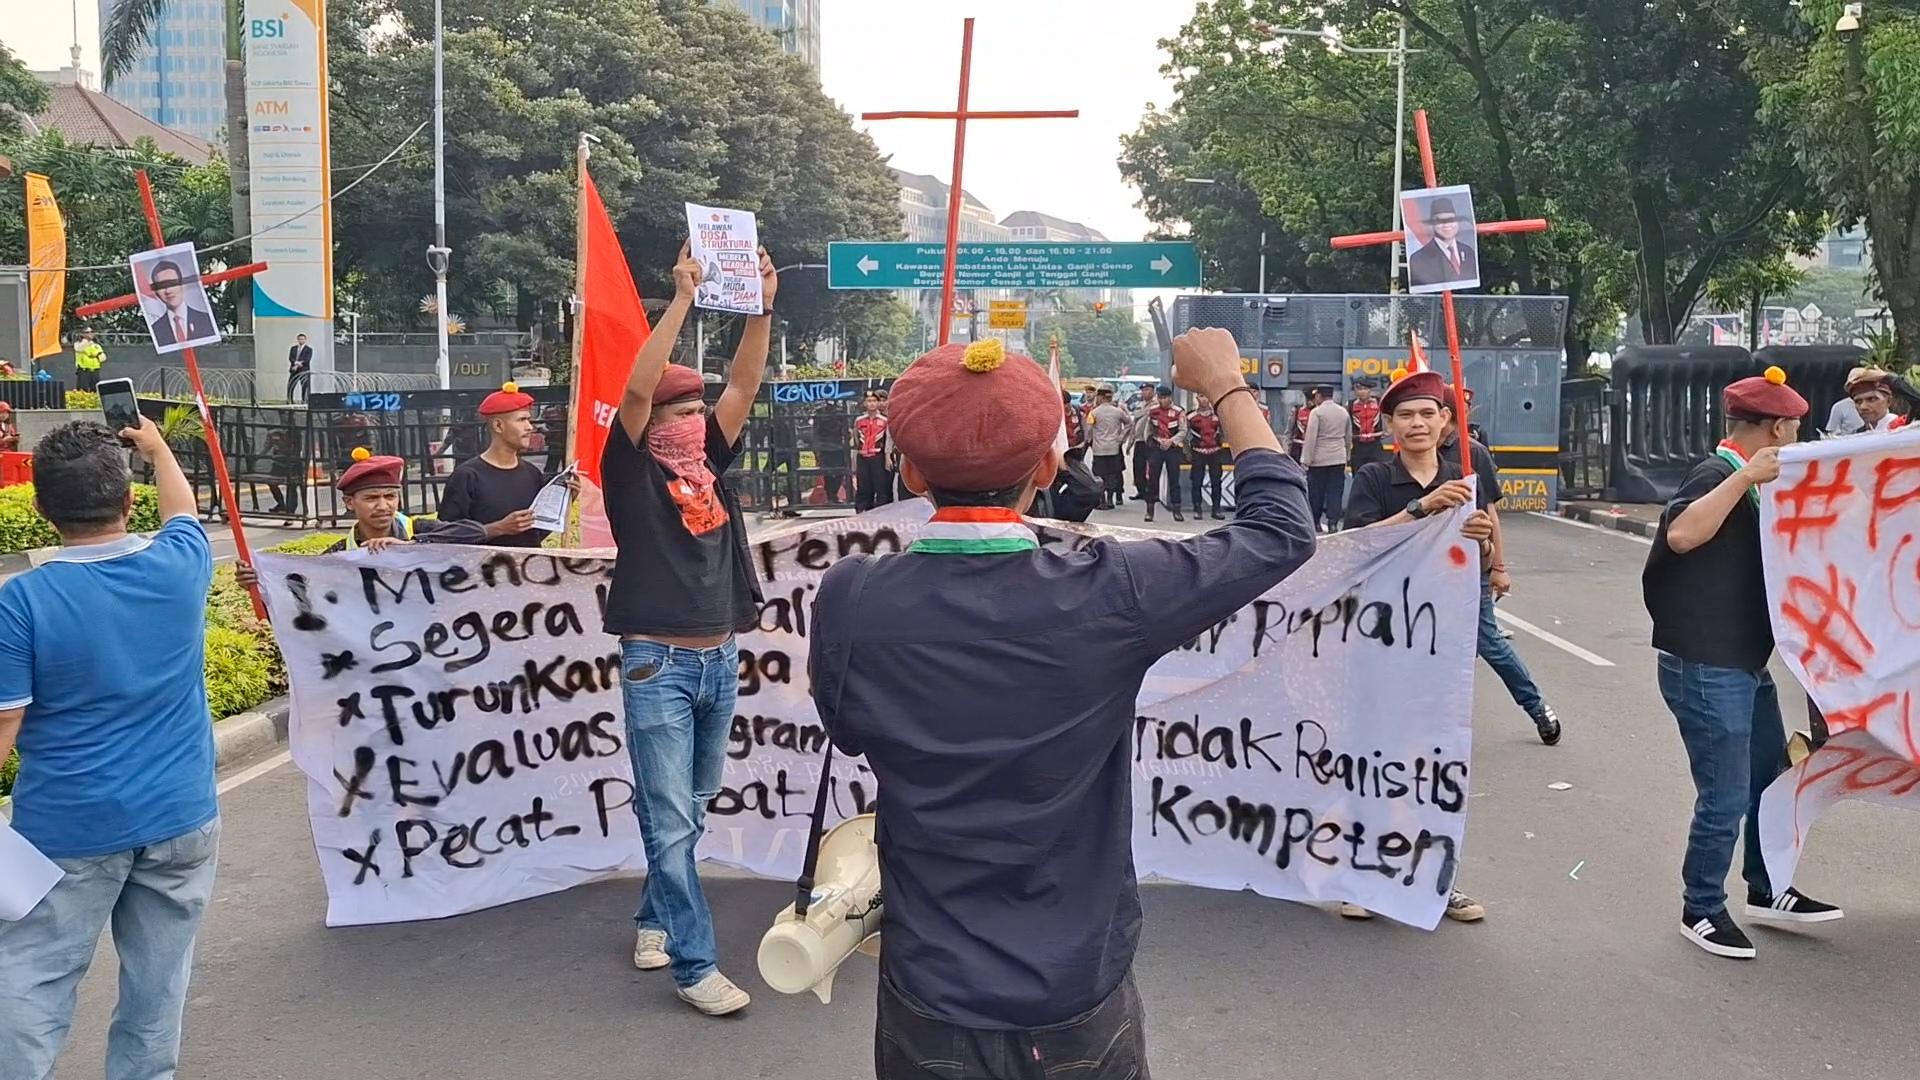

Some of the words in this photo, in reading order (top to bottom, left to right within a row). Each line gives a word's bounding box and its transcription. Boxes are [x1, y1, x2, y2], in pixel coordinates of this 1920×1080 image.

[252, 19, 284, 38] BSI
[256, 101, 288, 115] ATM
[698, 223, 733, 231] MELAWAN
[701, 231, 728, 240] DOSA
[702, 240, 753, 249] STRUKTURAL
[995, 247, 1021, 255] 10.00
[1025, 247, 1046, 255] dan
[1084, 247, 1113, 255] 21.00
[1013, 255, 1049, 263] Menuju
[919, 270, 945, 278] Berpl
[958, 270, 990, 278] Nomor
[994, 270, 1022, 278] Ganjil
[1025, 270, 1035, 278] di
[1040, 270, 1078, 279] Tanggal
[1081, 270, 1109, 278] Ganjil
[722, 282, 745, 291] MUDA
[990, 278, 1023, 286] Genap
[1026, 278, 1036, 286] di
[1040, 278, 1080, 287] Tanggal
[1083, 278, 1116, 286] Genap
[773, 381, 856, 403] KONTOL
[1500, 479, 1548, 496] APTA
[1510, 497, 1547, 511] JAKPUS
[368, 601, 584, 675] Segera
[386, 710, 623, 808] Evaluas
[1133, 712, 1283, 774] Tidak
[1295, 718, 1468, 813] Realistis
[1147, 776, 1457, 897] Kompeten
